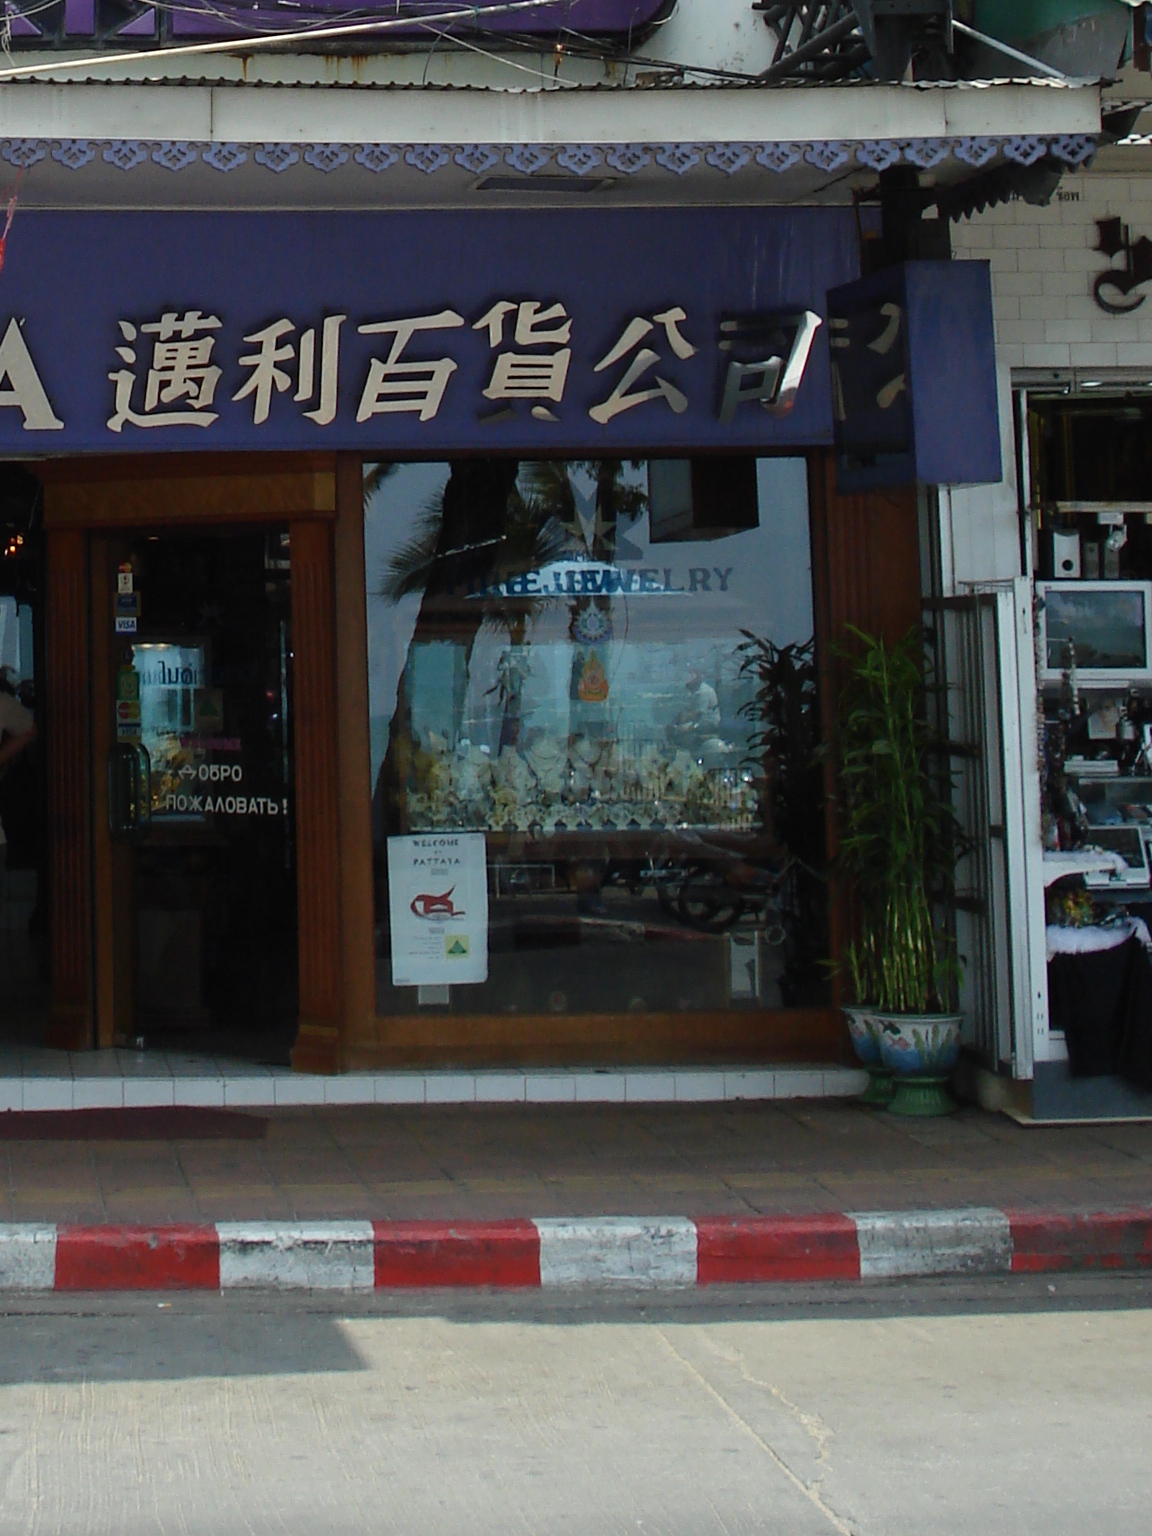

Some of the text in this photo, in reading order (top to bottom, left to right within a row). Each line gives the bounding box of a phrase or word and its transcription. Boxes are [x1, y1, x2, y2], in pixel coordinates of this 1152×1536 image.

[106, 300, 823, 432] 邁利百貨公司
[118, 620, 136, 630] VISA
[413, 857, 461, 866] PATTAYA
